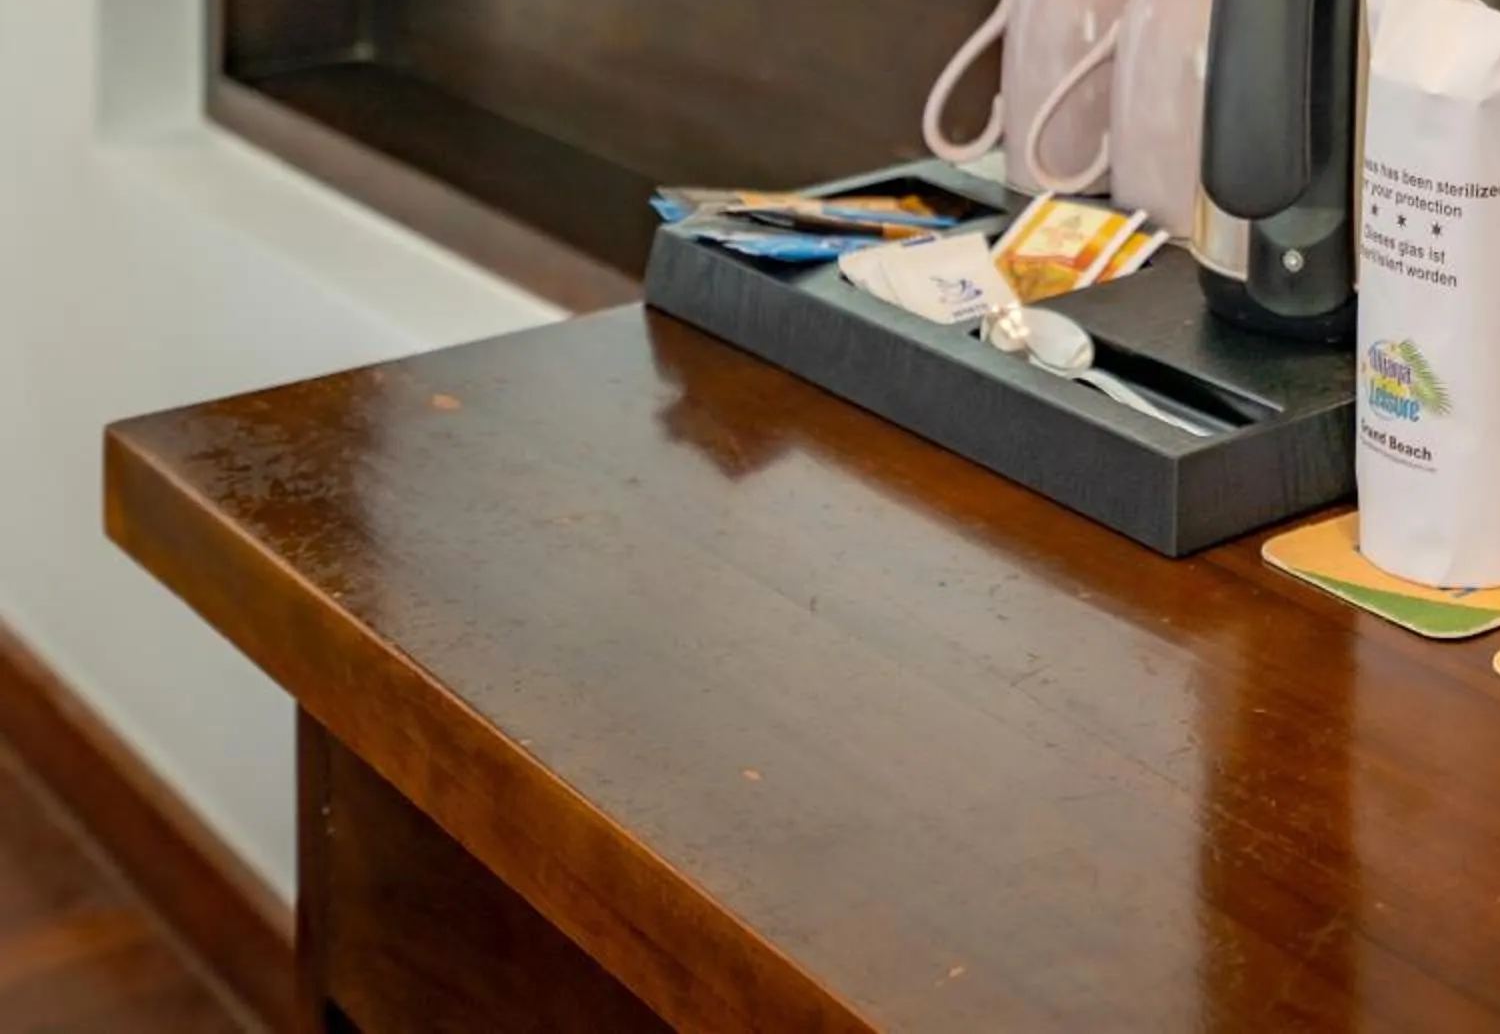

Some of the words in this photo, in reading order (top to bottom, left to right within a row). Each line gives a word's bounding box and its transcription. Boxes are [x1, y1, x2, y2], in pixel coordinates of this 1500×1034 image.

[1381, 163, 1399, 183] has
[1402, 170, 1434, 191] been
[1371, 183, 1392, 200] your
[1395, 192, 1462, 217] protection
[1398, 241, 1424, 259] glas
[1429, 247, 1446, 264] ist
[1407, 266, 1458, 287] worden
[1389, 435, 1432, 461] Beach
